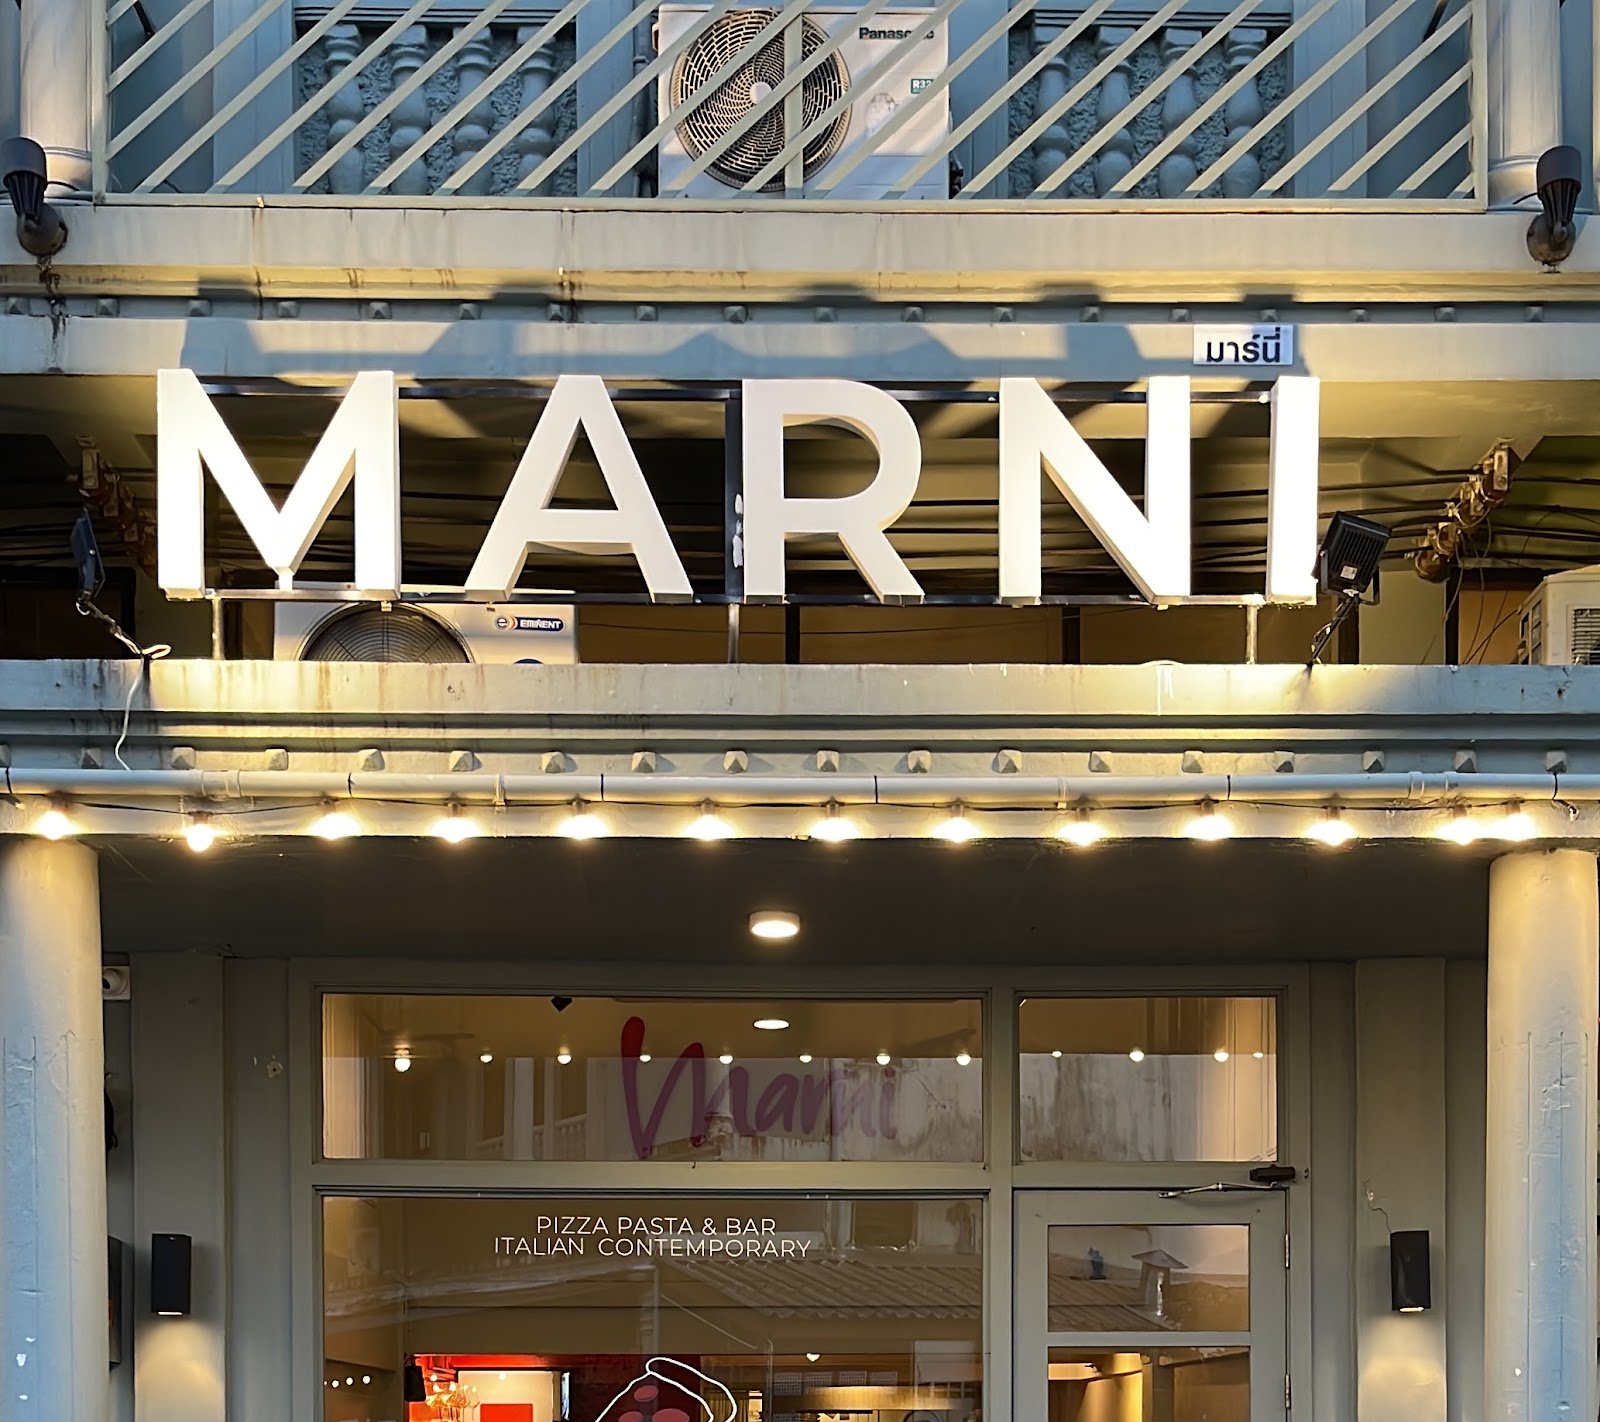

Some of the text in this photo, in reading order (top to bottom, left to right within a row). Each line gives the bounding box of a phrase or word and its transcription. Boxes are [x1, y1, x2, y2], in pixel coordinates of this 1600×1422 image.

[859, 27, 934, 39] Panasc
[1206, 327, 1281, 363] มาร์นี่
[157, 368, 1320, 606] MARNI
[519, 619, 562, 629] EMINENT
[621, 1016, 897, 1159] Marni
[537, 1216, 776, 1236] PIZZA PASTA & BAR
[495, 1237, 811, 1258] ITALIAN CONTEMPORARY
